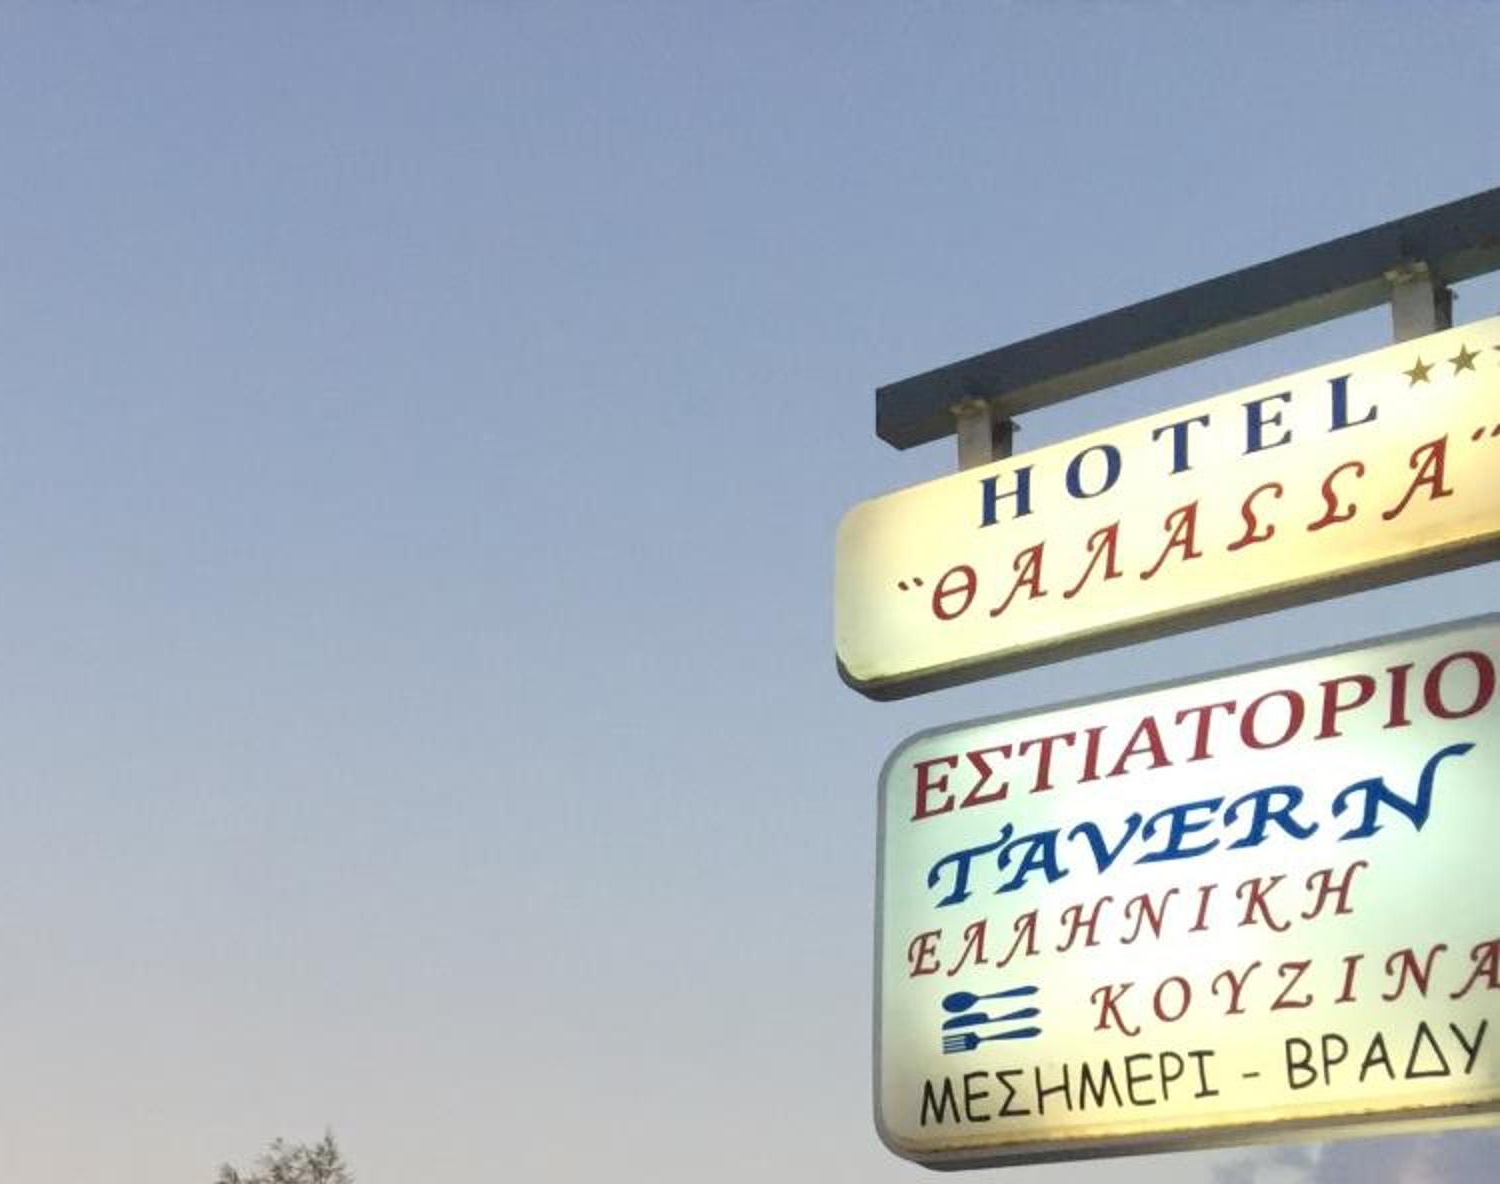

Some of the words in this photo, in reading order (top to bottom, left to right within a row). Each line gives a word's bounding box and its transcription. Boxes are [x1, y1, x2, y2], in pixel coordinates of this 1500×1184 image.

[978, 373, 1378, 529] HOTEL
[910, 651, 1496, 822] ΕΣΤΙΑΤΟΡΙΟ
[907, 860, 1369, 978] ΕΛΛΗΝΙΚΗ
[1090, 937, 1500, 1037] ΚΟΥΖΙΝΑ
[919, 1049, 1220, 1128] ΜΕΣΗΜΕΡΙ
[1285, 1018, 1489, 1091] ΒΡΑΔΥ
